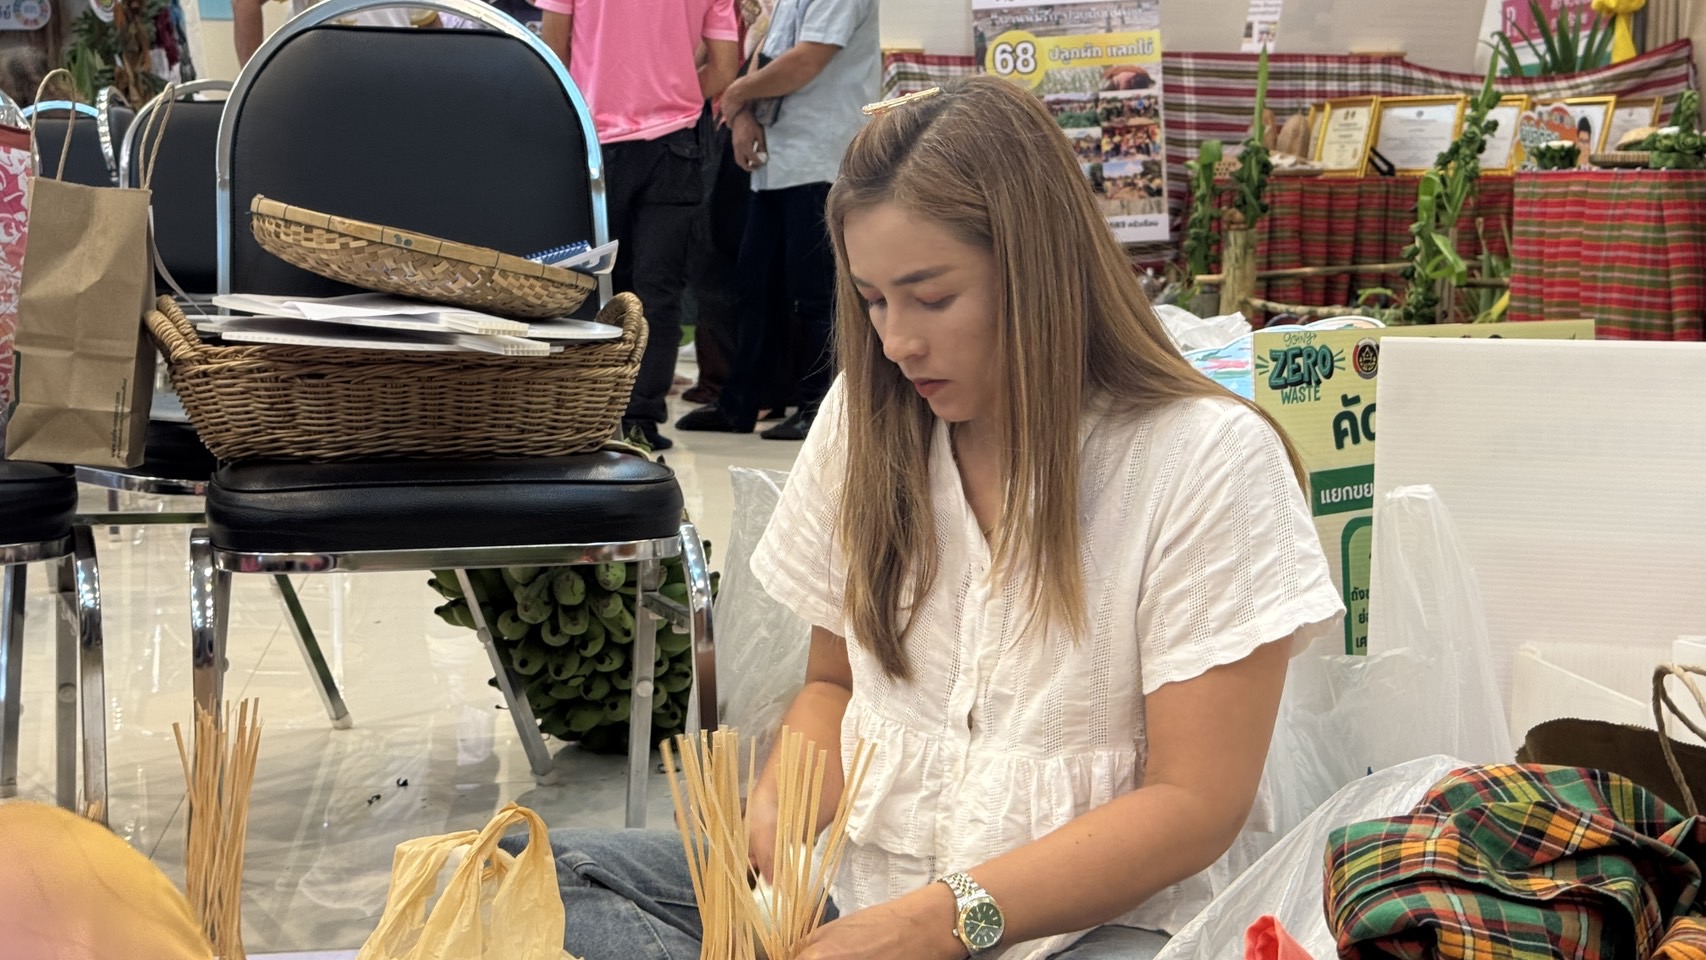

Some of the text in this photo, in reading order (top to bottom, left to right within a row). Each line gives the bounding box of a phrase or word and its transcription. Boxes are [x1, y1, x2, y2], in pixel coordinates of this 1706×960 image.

[993, 41, 1037, 75] 68
[1048, 43, 1103, 64] ปลูกผัก
[1268, 344, 1335, 390] ZERO
[1281, 385, 1321, 405] WASTE
